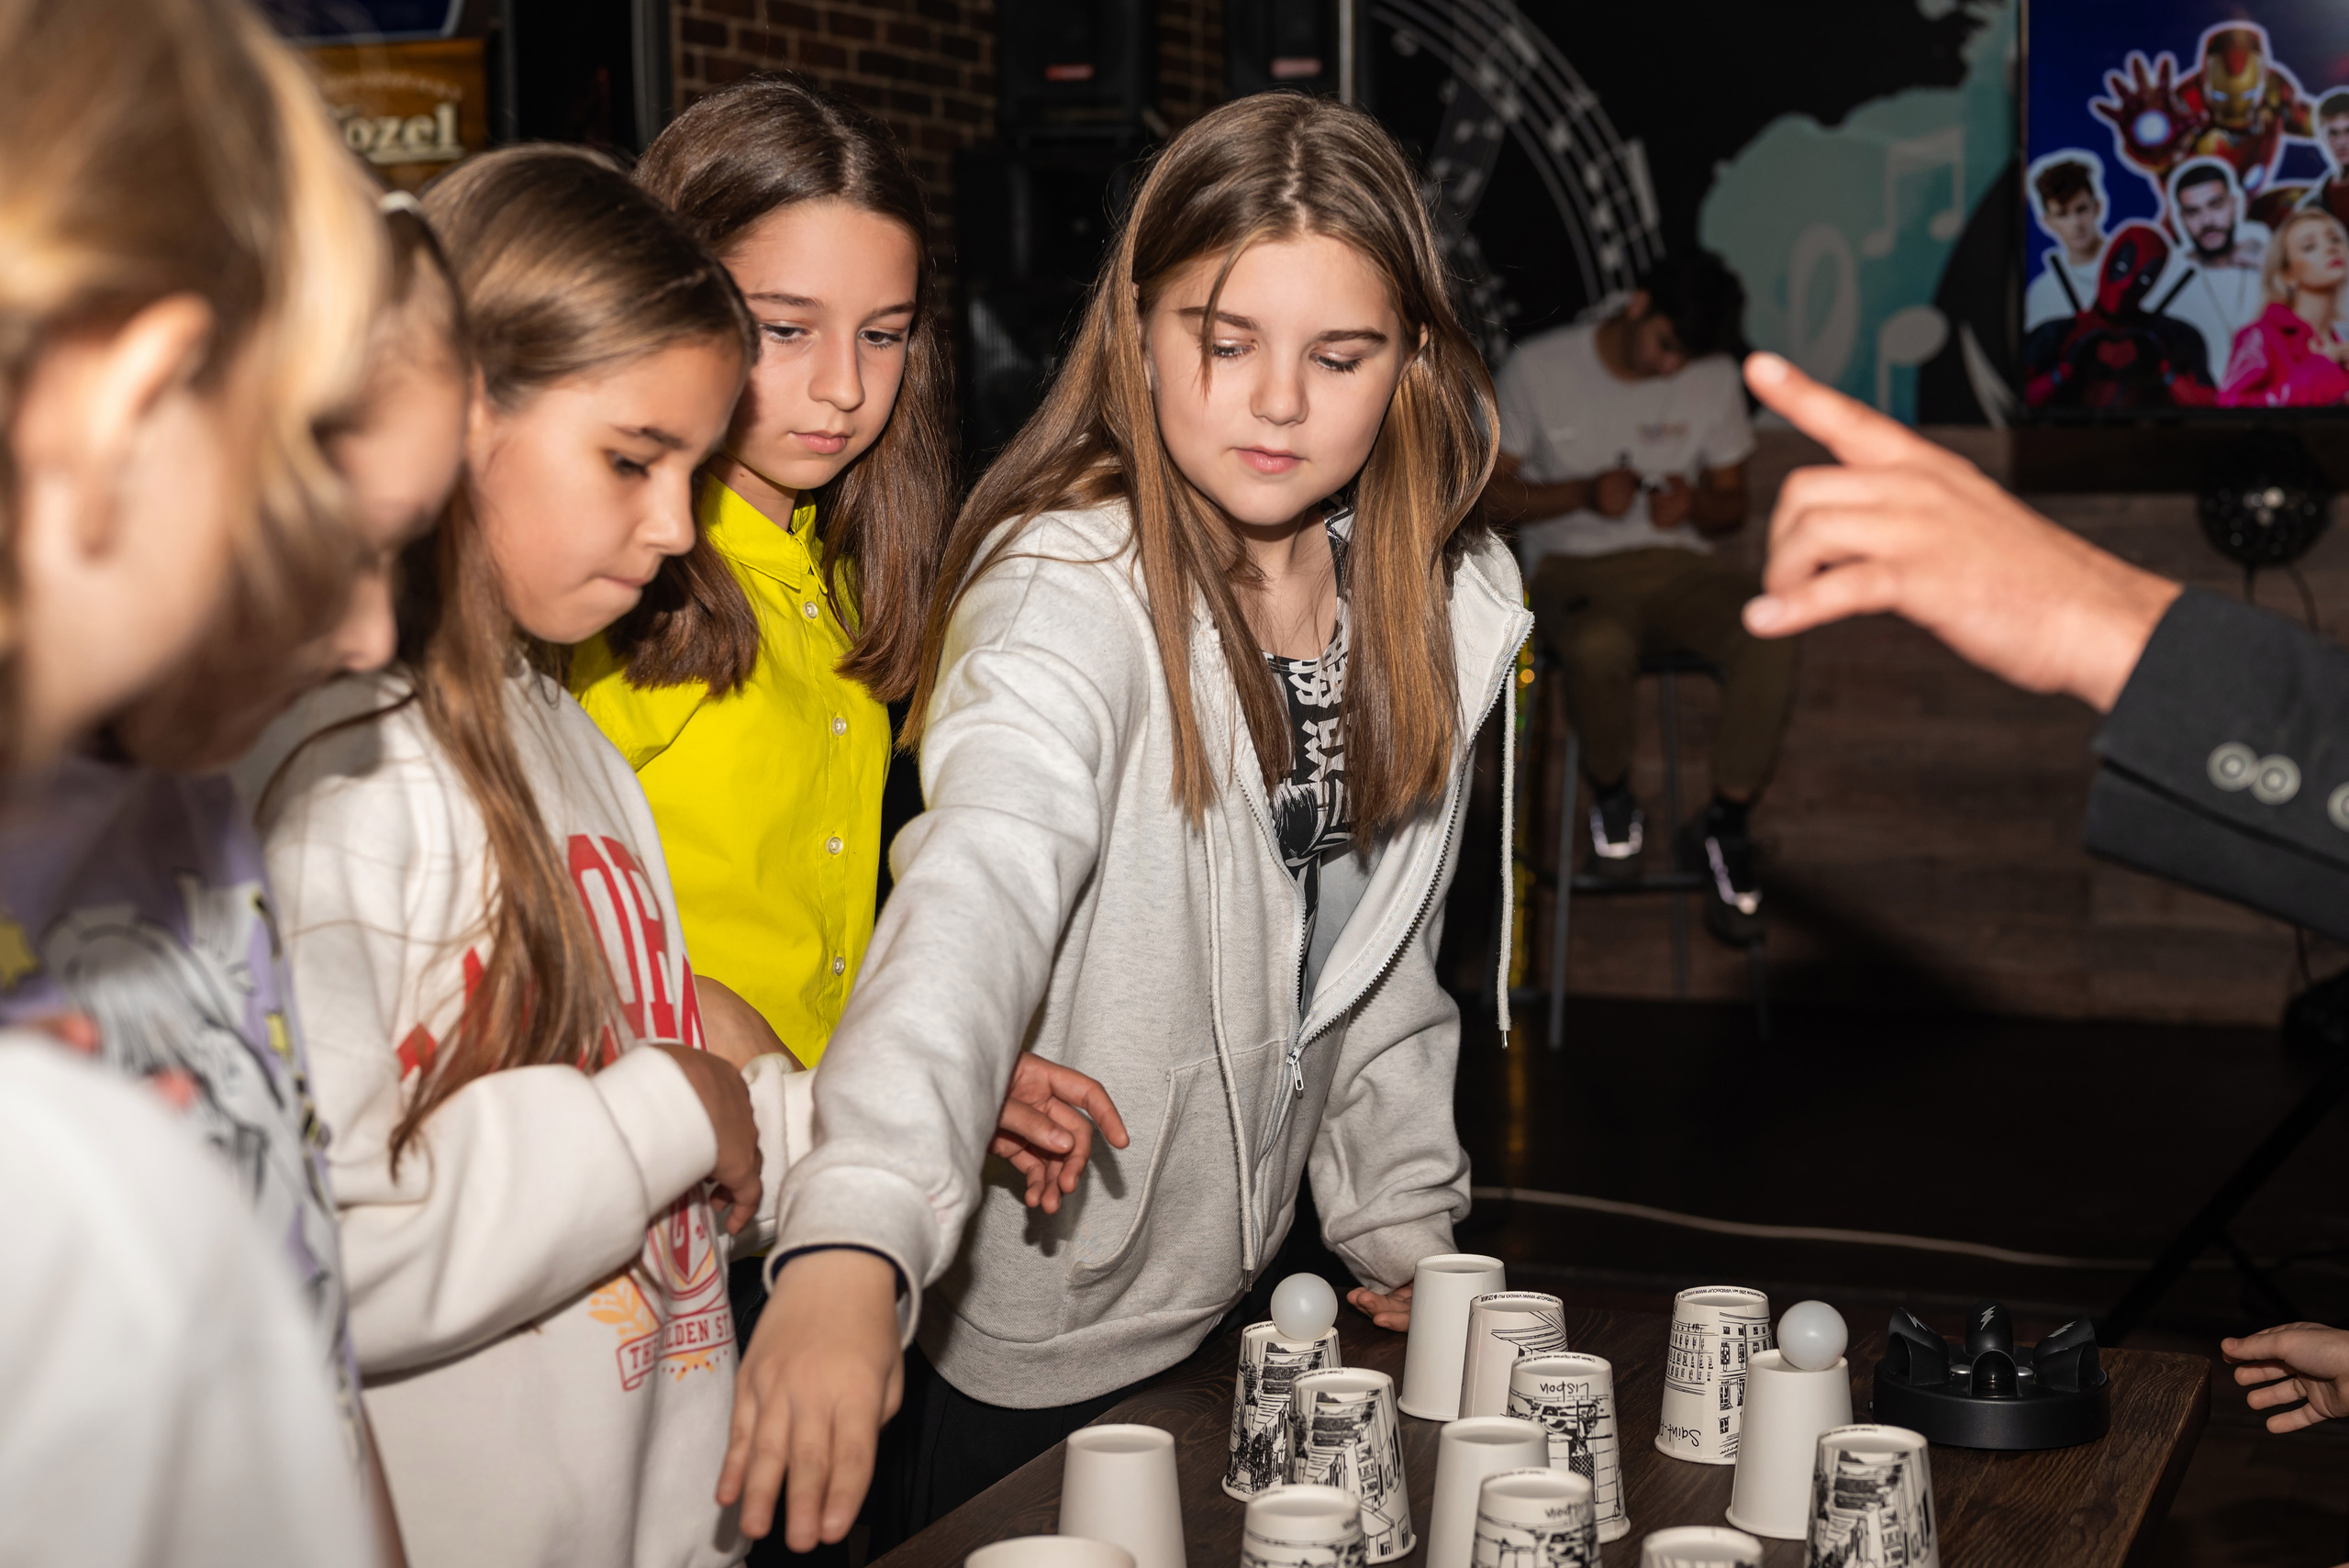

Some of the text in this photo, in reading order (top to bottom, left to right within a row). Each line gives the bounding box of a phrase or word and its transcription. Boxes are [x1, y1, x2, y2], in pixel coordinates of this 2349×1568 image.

[340, 102, 461, 152] ozel
[629, 1338, 658, 1370] TH
[661, 1319, 709, 1350] LDEN
[1540, 1380, 1589, 1403] Lisbon
